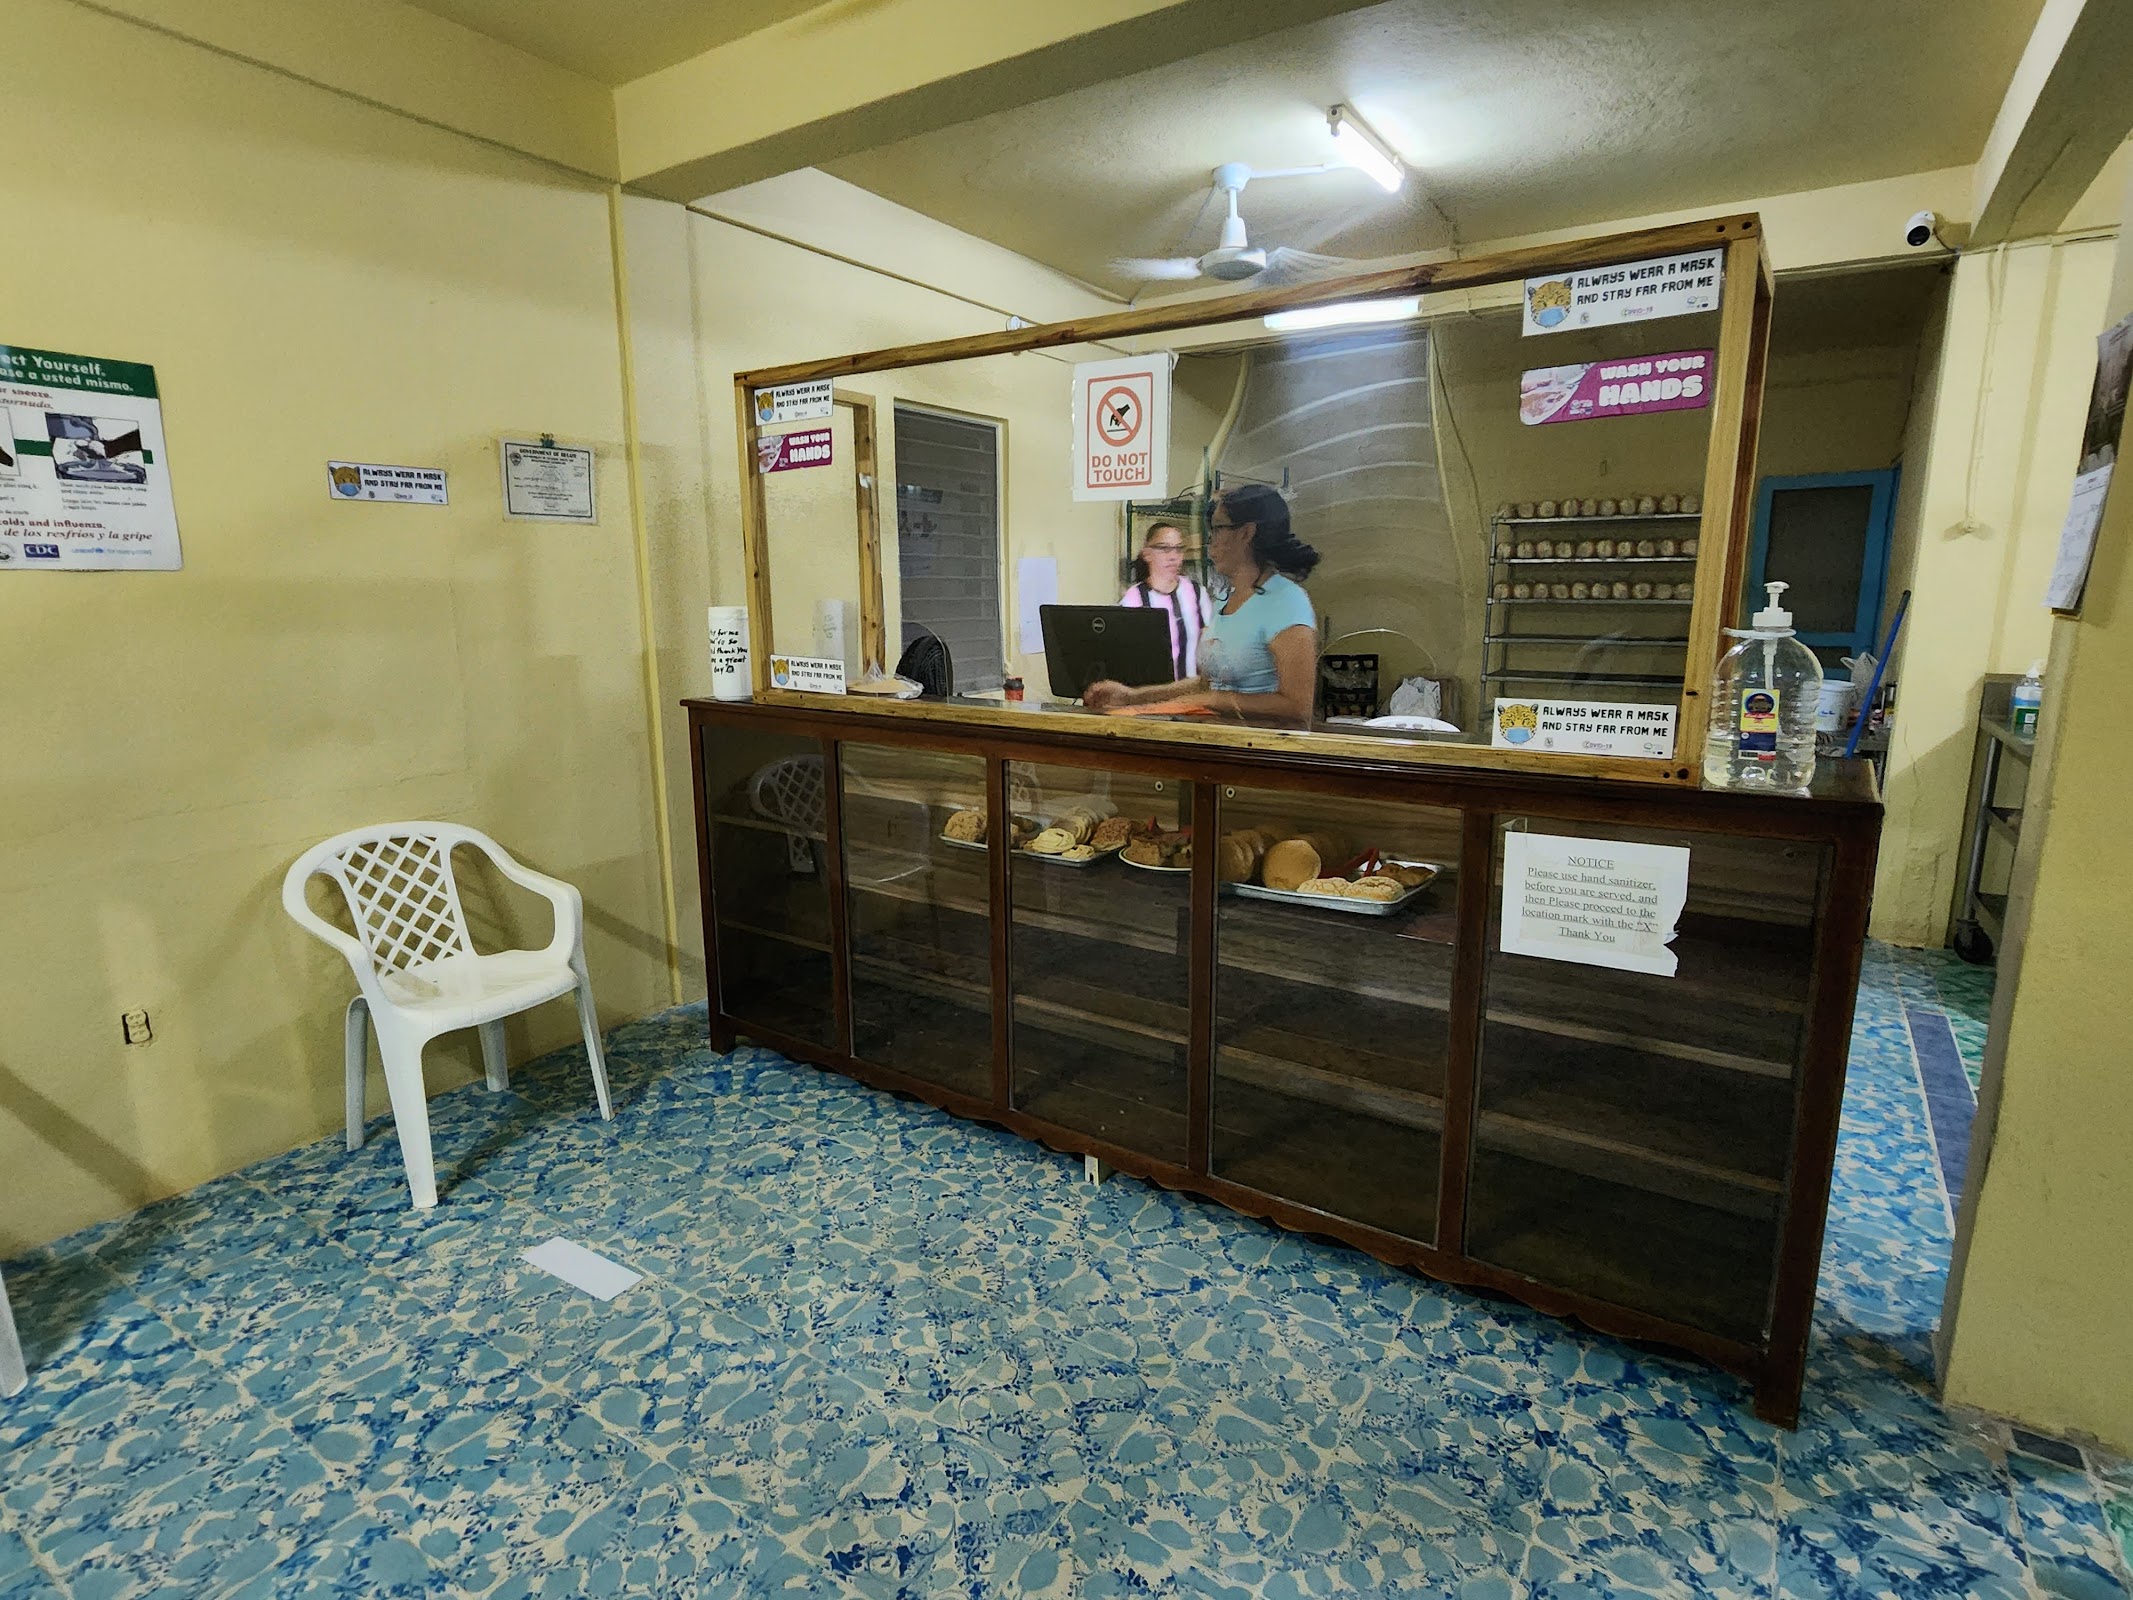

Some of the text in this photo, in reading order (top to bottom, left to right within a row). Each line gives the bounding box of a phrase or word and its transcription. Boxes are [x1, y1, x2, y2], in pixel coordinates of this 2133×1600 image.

[1577, 257, 1716, 288] ALWAYS WEAR A MASK
[1577, 276, 1714, 305] AND STAY FAR FROM ME
[32, 355, 106, 376] Yourself.
[1600, 356, 1705, 380] WASH YOUR
[28, 372, 38, 380] a
[42, 374, 81, 386] usted
[86, 378, 134, 392] mismo.
[776, 389, 795, 398] ALWAYS
[796, 387, 810, 395] WEAR
[817, 384, 830, 392] MASK
[1599, 375, 1703, 406] HANDS
[789, 432, 830, 446] WASH YOUR
[789, 444, 830, 463] HANDS
[1092, 452, 1148, 468] DO NOT
[363, 469, 393, 477] ALWAYS
[395, 470, 414, 478] WEAR
[424, 472, 442, 480] MASK
[1094, 467, 1144, 482] TOUCH
[381, 480, 398, 488] STAY
[54, 520, 106, 529] influenza.
[4, 528, 20, 537] de
[24, 528, 42, 537] los
[98, 532, 106, 540] y
[108, 531, 119, 539] la
[122, 532, 152, 541] gripe
[25, 546, 58, 555] CDC
[725, 655, 746, 666] great
[791, 660, 809, 668] ALWAYS
[1543, 706, 1669, 721] ALWAYS WEAR A MASK
[1542, 722, 1668, 737] AND STAY FAR FROM ME
[1568, 856, 1614, 870] NOTICE
[1528, 867, 1558, 879] Please
[1561, 873, 1578, 881] use
[1581, 872, 1606, 884] hand
[1524, 880, 1658, 905] before you are served, and
[1524, 894, 1656, 919] then Please proceed to the
[1522, 907, 1560, 920] location
[1563, 914, 1589, 924] mark
[1592, 916, 1614, 928] with
[1617, 919, 1634, 930] the
[1559, 926, 1615, 944] Thank You
